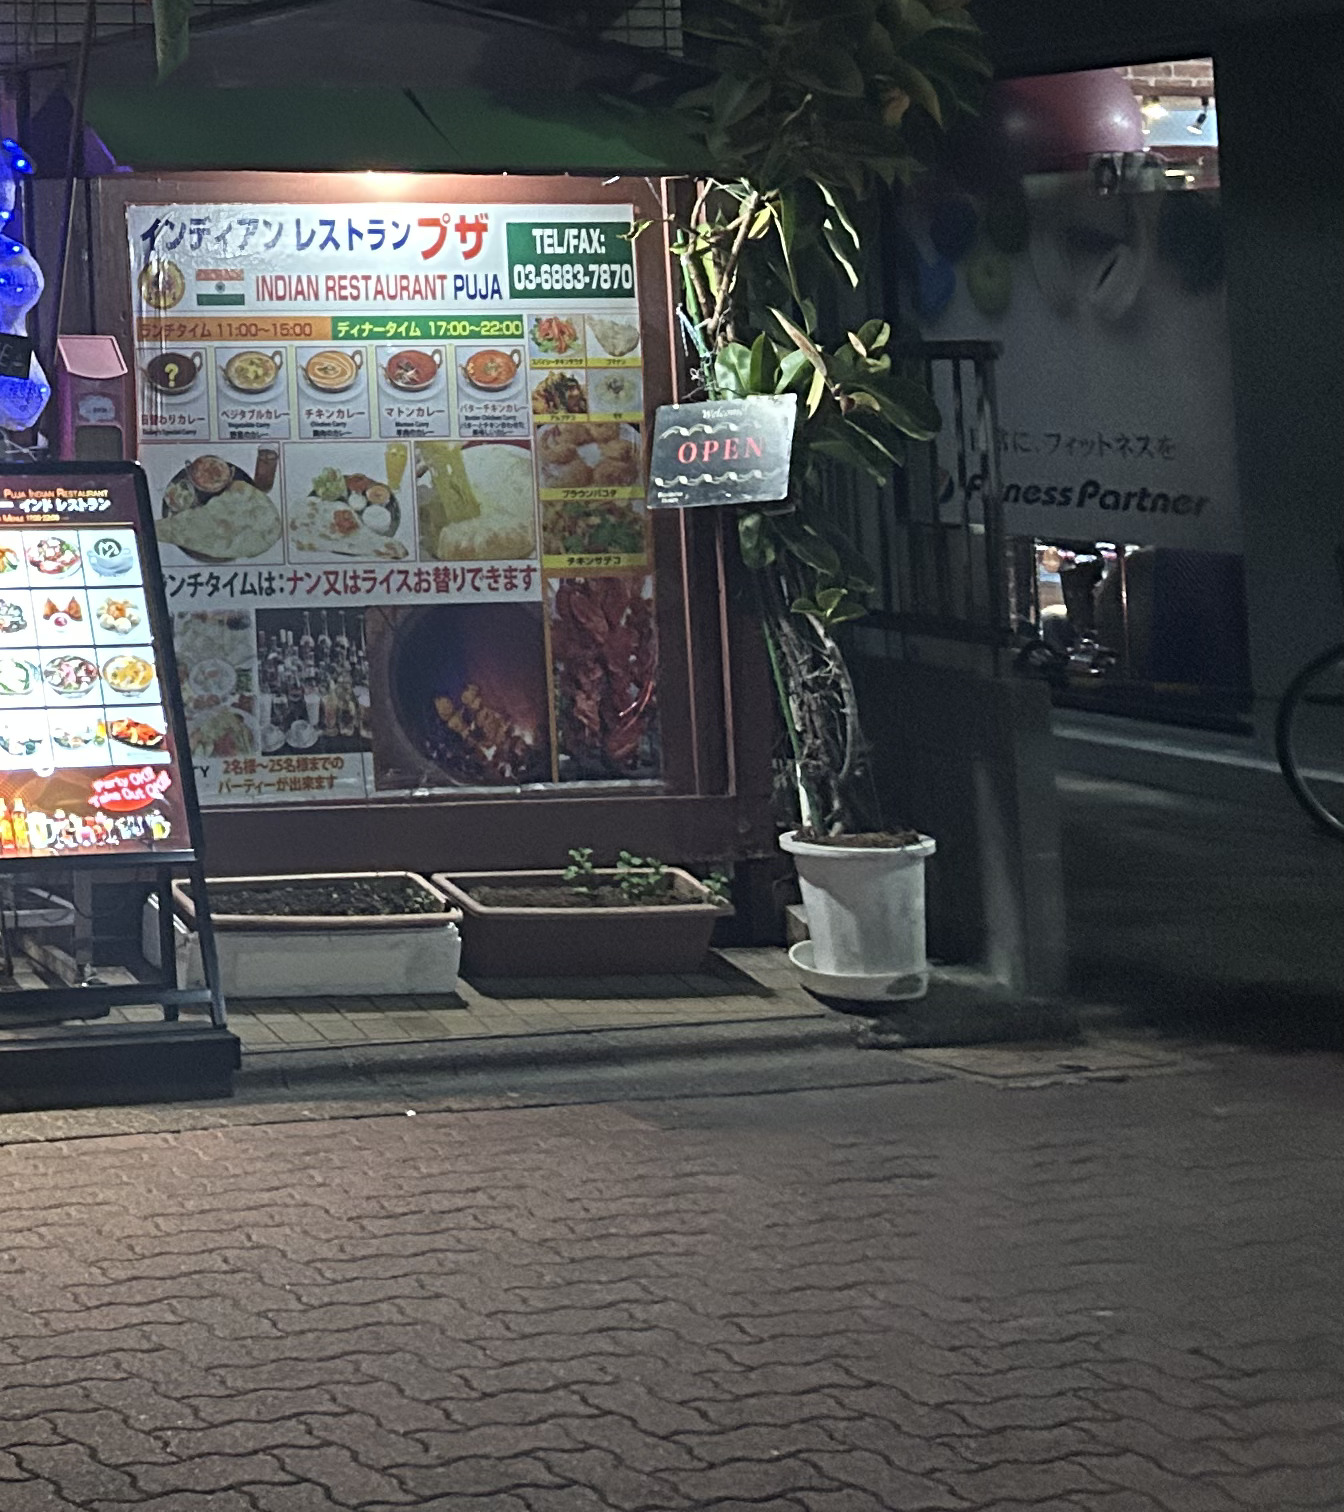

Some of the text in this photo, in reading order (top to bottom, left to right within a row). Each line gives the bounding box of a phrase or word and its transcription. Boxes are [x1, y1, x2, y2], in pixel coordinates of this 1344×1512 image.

[140, 212, 489, 261] インディアン レストラン プザ
[531, 228, 606, 255] TEL/FAX:
[255, 273, 504, 302] INDIAN RESTAURANT PUJA
[513, 263, 633, 291] 03-6883-7870
[140, 322, 211, 337] ランチタイム
[337, 321, 421, 337] ディナータイム
[220, 408, 290, 420] ベジタブルカレー
[305, 408, 366, 420] チキンカレー
[384, 407, 445, 418] マトンカレー
[677, 437, 762, 464] OPEN
[164, 565, 537, 599] ンチタイムは:ナン又はライスお替りできます
